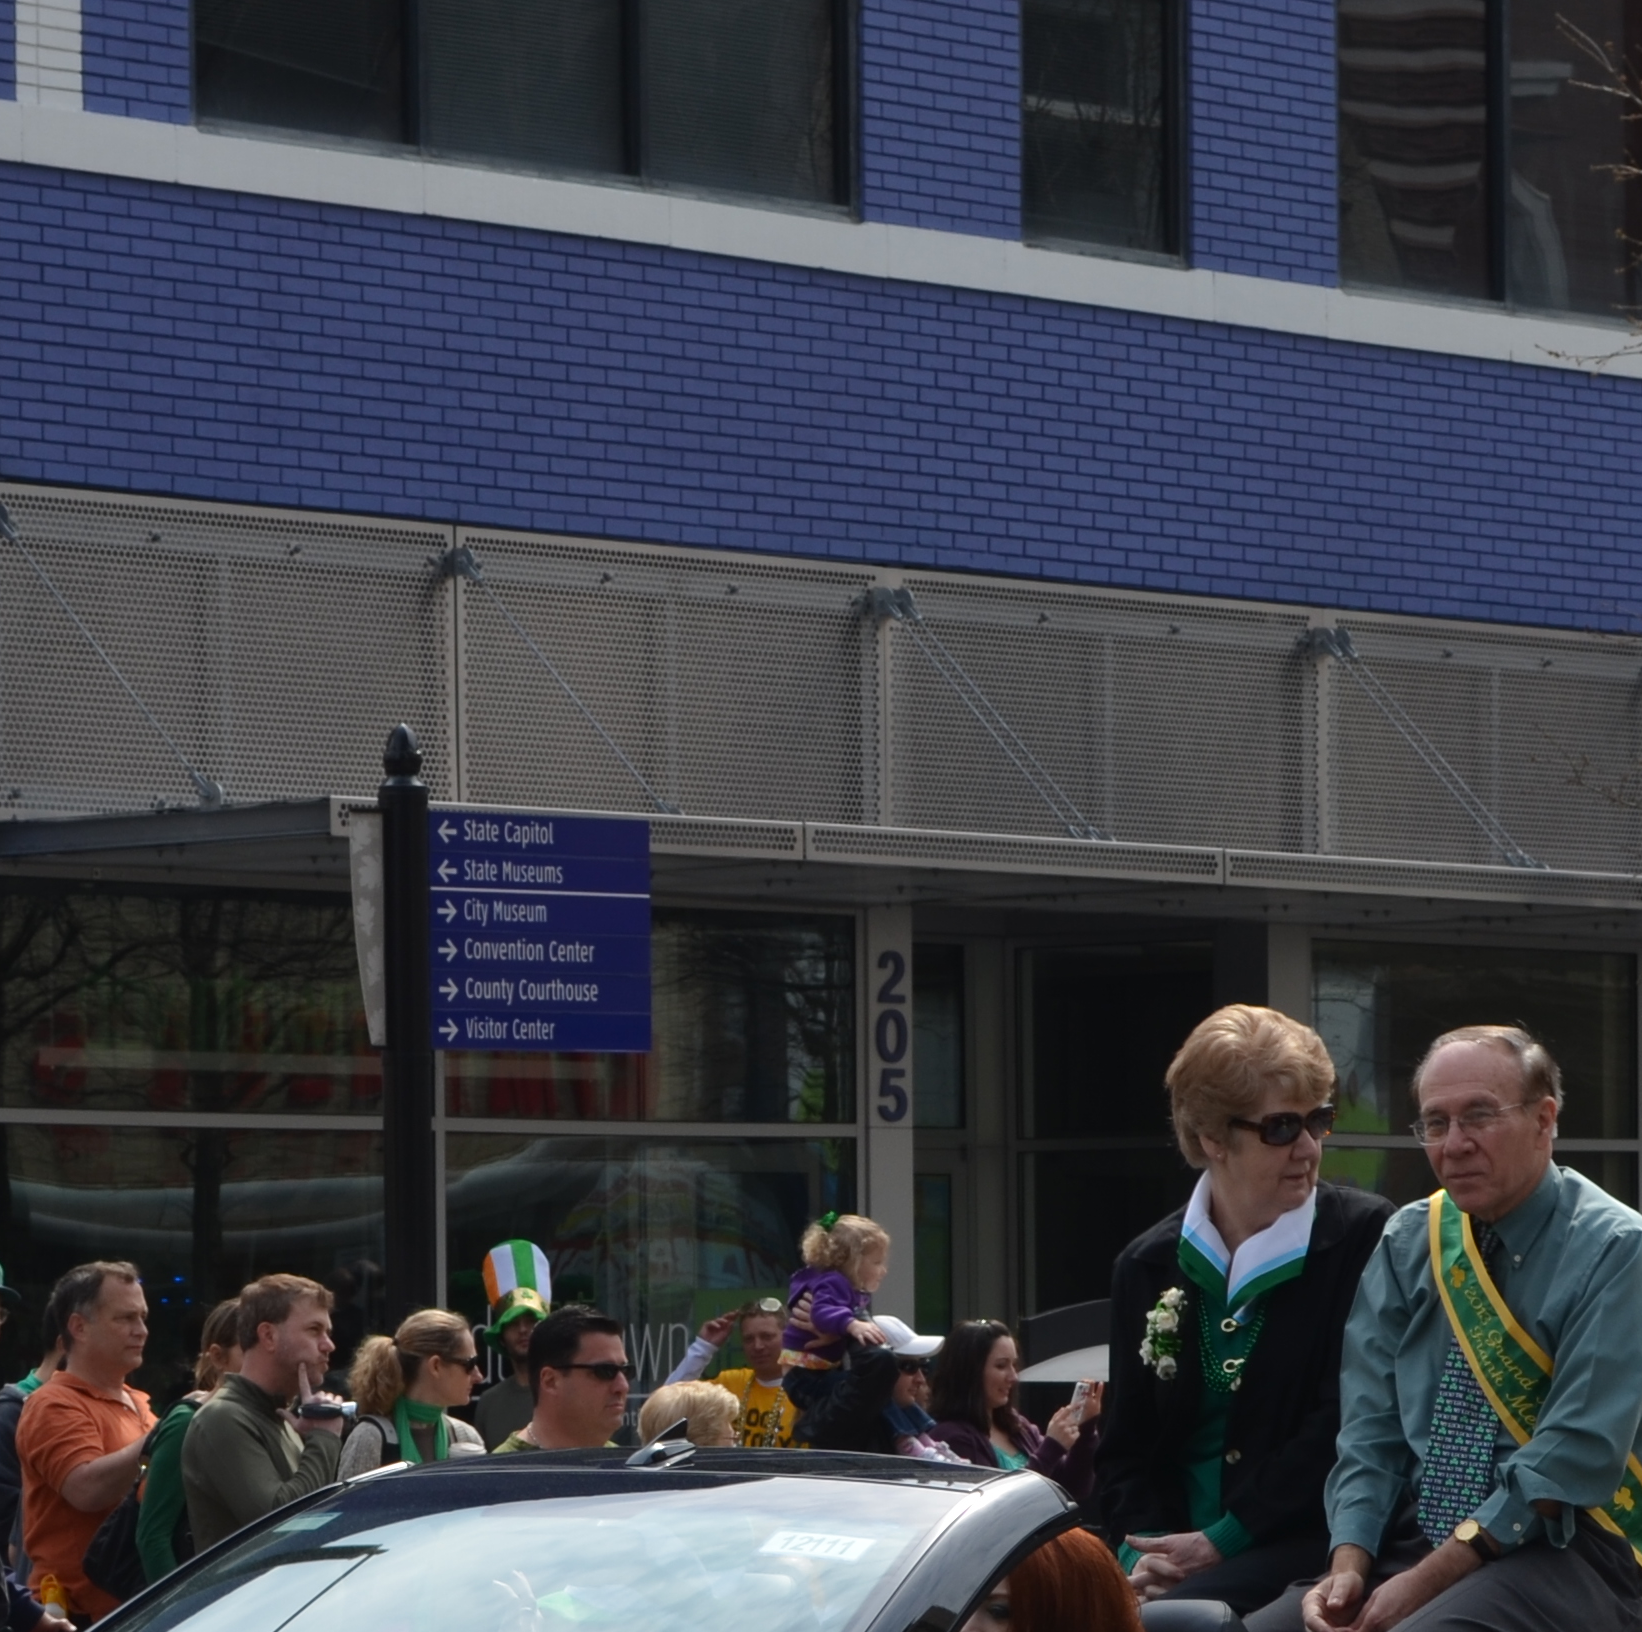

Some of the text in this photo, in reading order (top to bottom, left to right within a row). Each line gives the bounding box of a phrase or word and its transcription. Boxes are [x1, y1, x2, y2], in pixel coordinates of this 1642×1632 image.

[463, 819, 554, 849] State Capitol
[463, 859, 564, 884] State Museums
[464, 898, 547, 927] City Museum
[464, 938, 595, 963] Convention Center
[465, 977, 599, 1005] County Courthouse
[466, 1016, 555, 1040] Visitor Center
[874, 950, 909, 1122] 205
[1464, 1286, 1539, 1391] 2013 Grand
[1470, 1325, 1537, 1428] Frank Me
[780, 1534, 855, 1555] 12111
